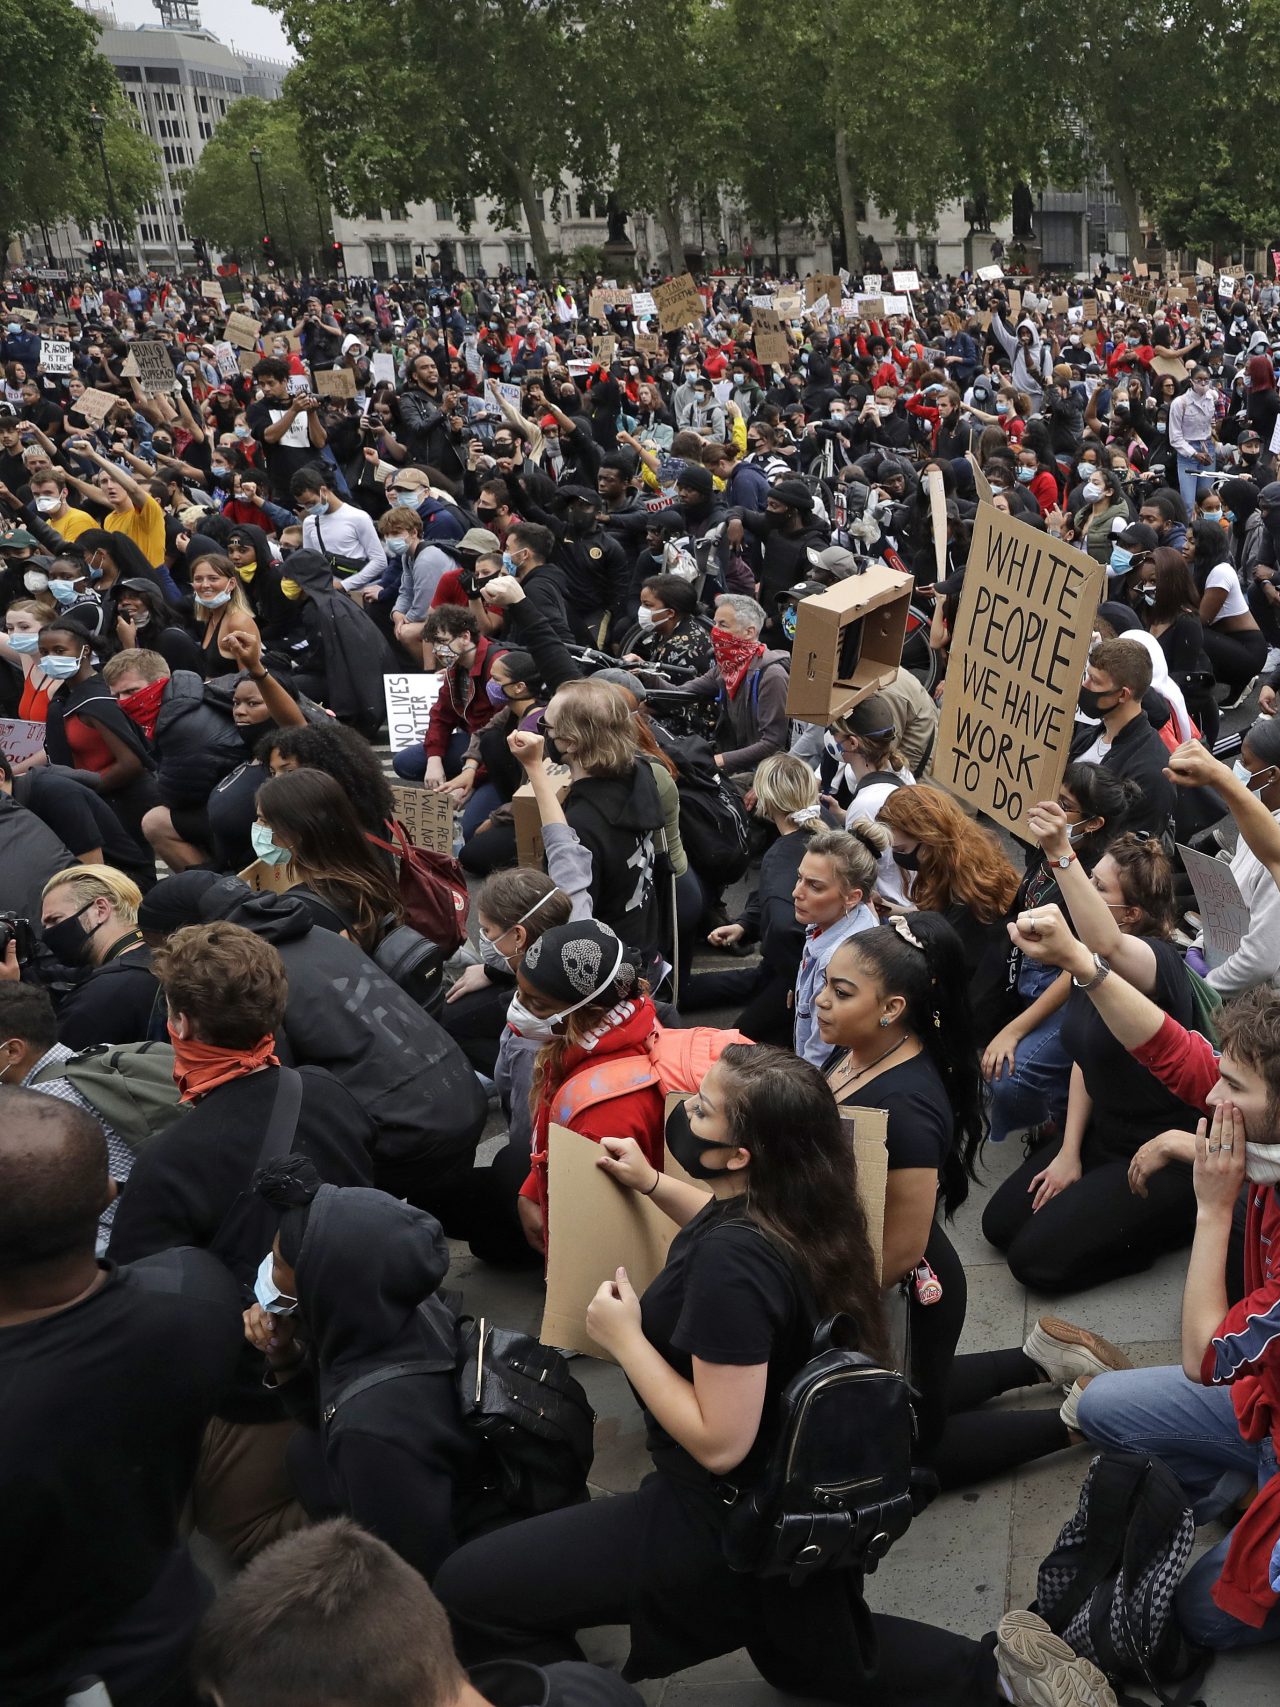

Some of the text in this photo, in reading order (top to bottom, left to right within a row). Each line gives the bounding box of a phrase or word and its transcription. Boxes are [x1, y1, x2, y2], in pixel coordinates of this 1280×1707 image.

[986, 525, 1084, 619] WHITE
[968, 586, 1076, 695] PEOPLE
[389, 676, 415, 749] NO LIVES
[963, 653, 1066, 752] WE HAVE
[952, 747, 1022, 821] TO DO
[957, 707, 1040, 791] WORK
[420, 794, 434, 853] WILL NOT
[436, 797, 449, 822] THE
